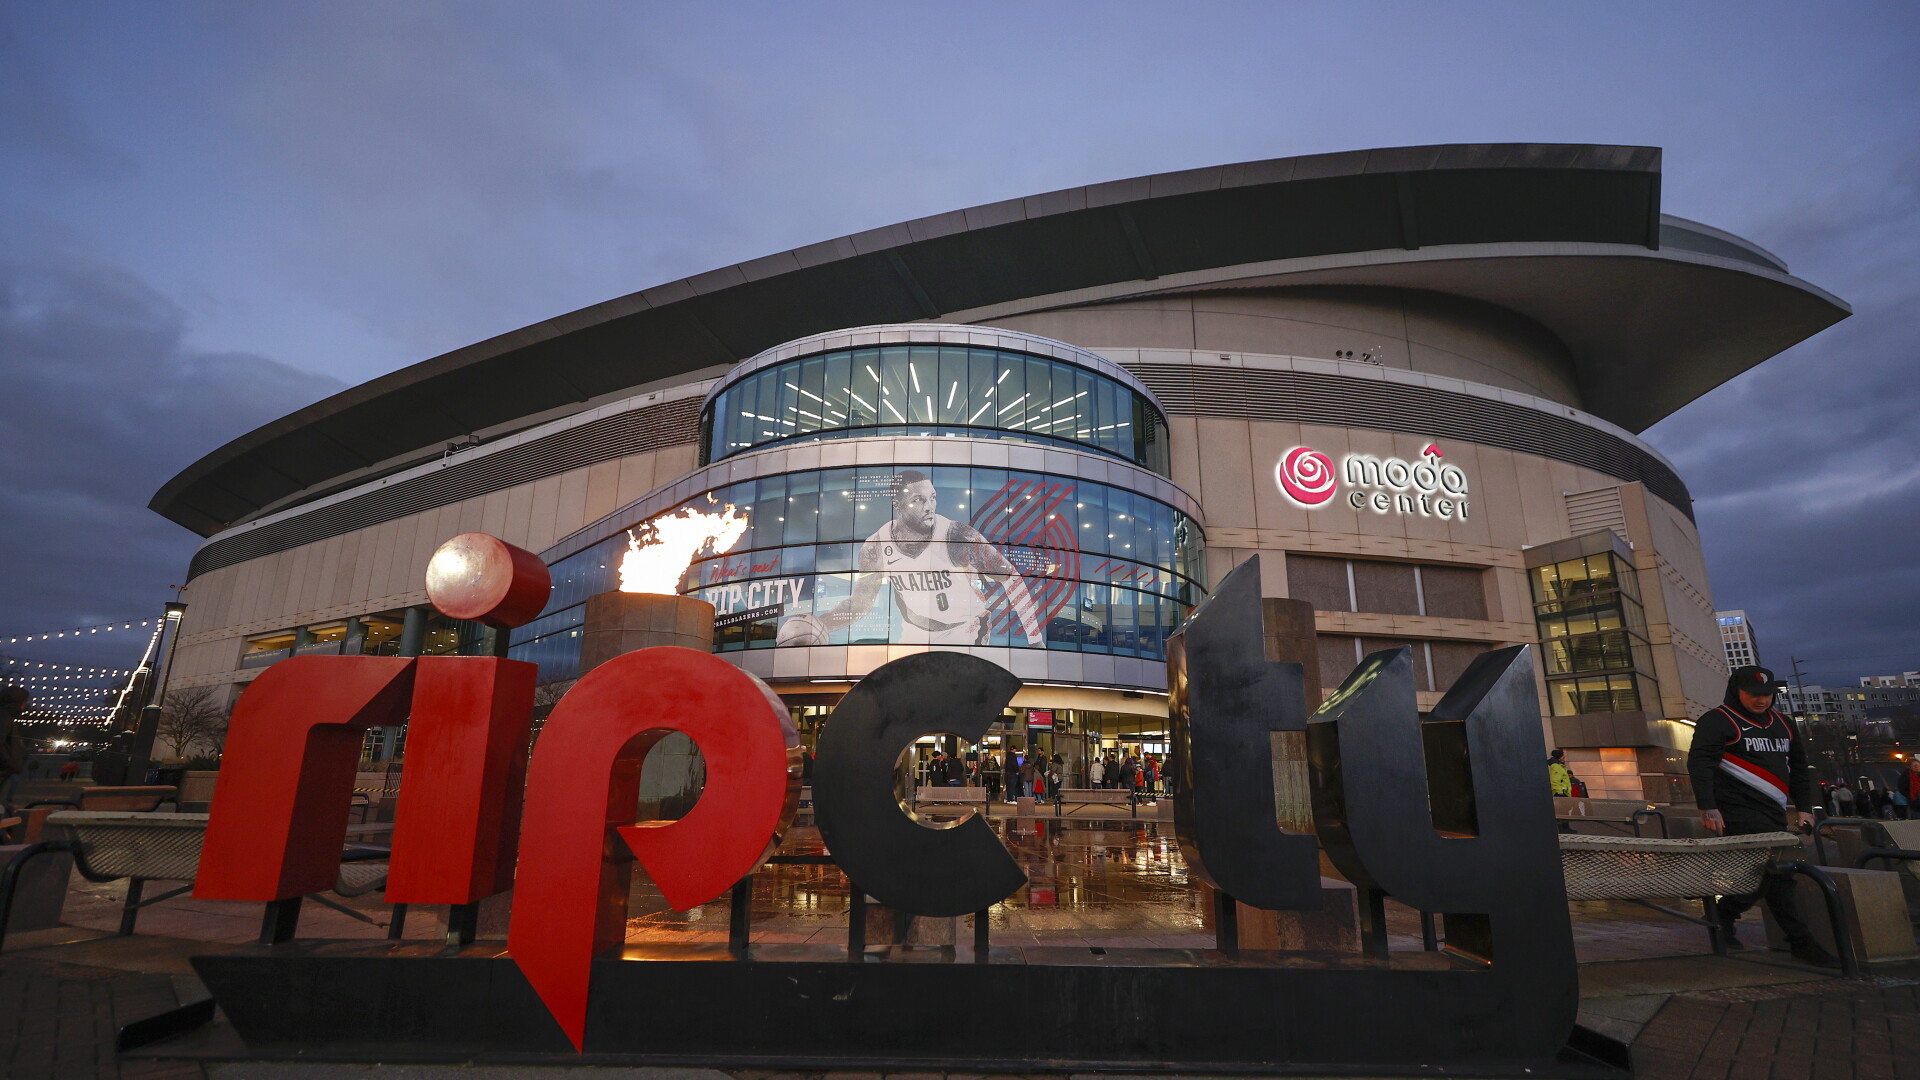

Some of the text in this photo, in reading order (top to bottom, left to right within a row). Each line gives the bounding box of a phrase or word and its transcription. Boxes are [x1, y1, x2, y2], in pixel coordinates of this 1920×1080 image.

[1346, 444, 1468, 494] moda
[1350, 489, 1470, 518] center
[750, 554, 780, 574] next
[888, 569, 953, 592] BLAZERS
[706, 578, 805, 616] RIP CITY
[936, 592, 950, 612] 0
